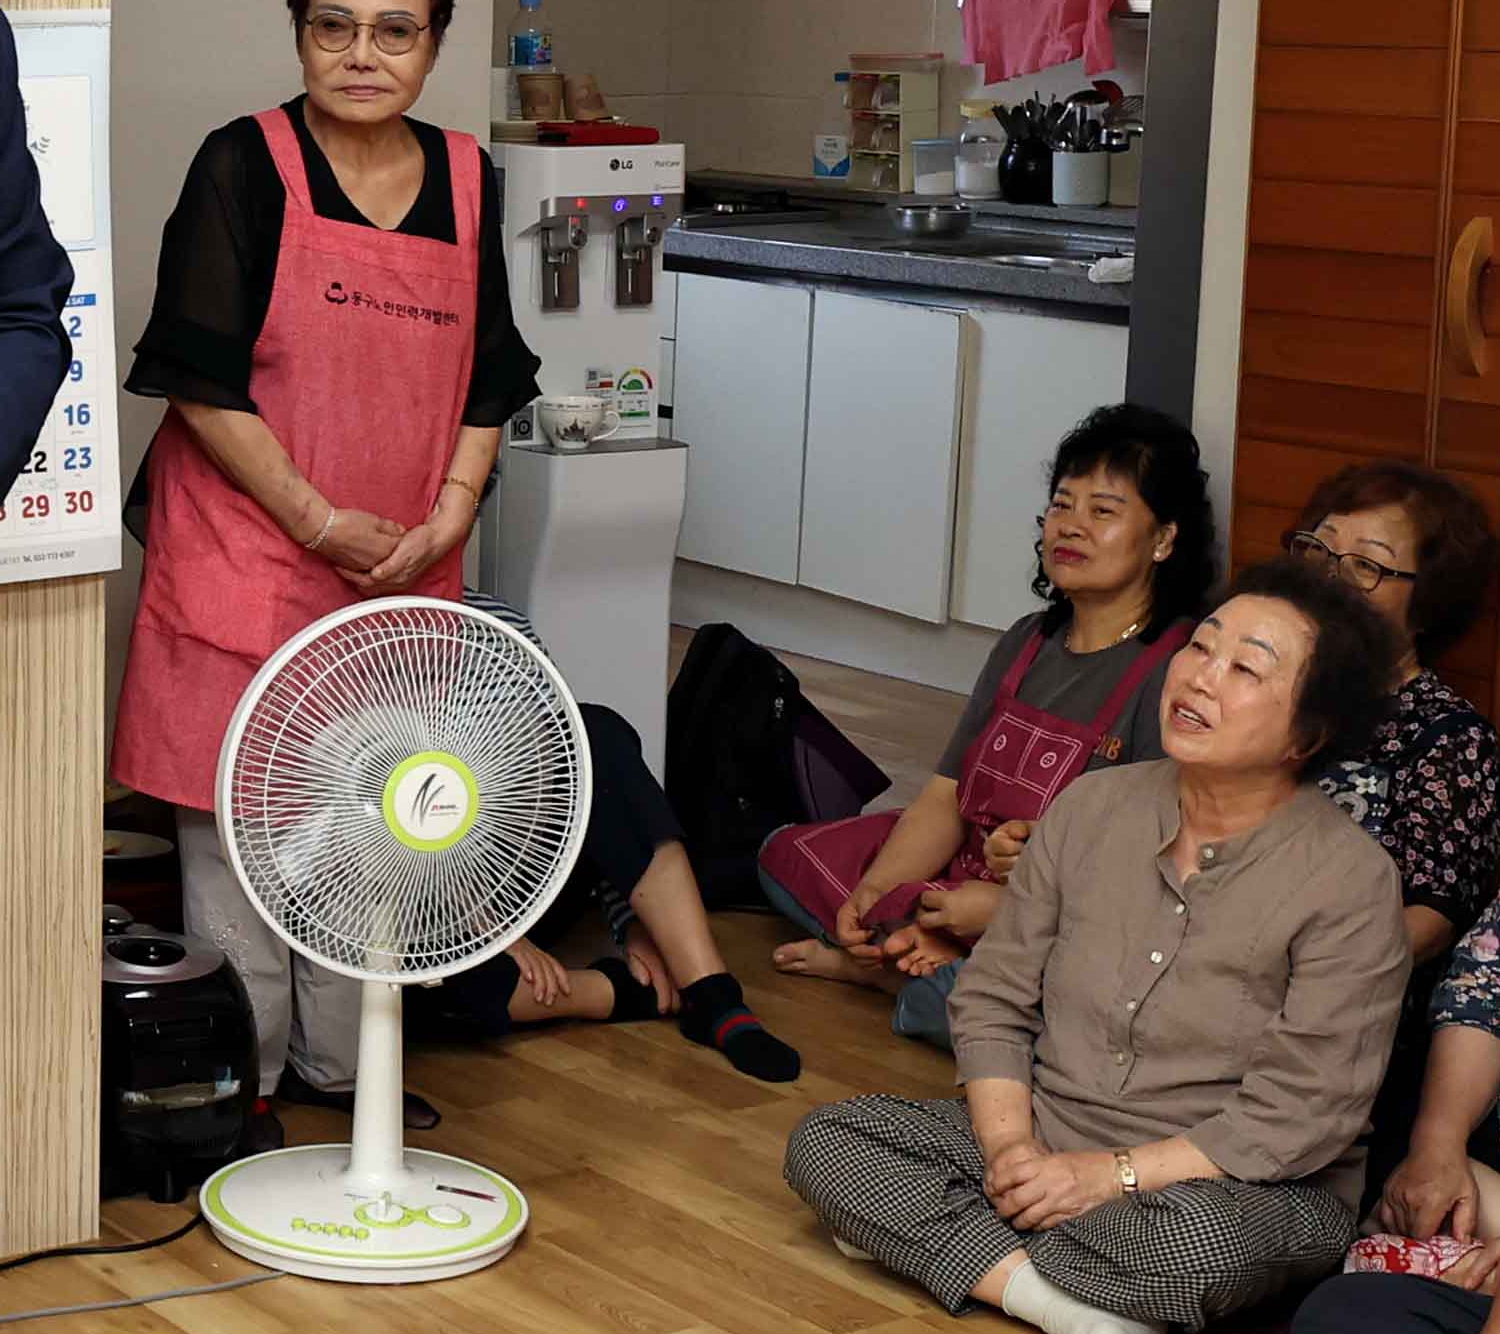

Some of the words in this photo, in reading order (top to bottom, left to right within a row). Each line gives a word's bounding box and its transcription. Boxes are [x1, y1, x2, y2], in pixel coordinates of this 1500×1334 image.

[621, 161, 633, 170] LG
[72, 295, 86, 305] SAT
[69, 316, 82, 337] 2
[71, 360, 83, 381] 9
[63, 403, 91, 425] 16
[513, 420, 531, 436] 10
[63, 447, 92, 470] 23
[22, 495, 50, 518] 29
[65, 490, 93, 514] 30
